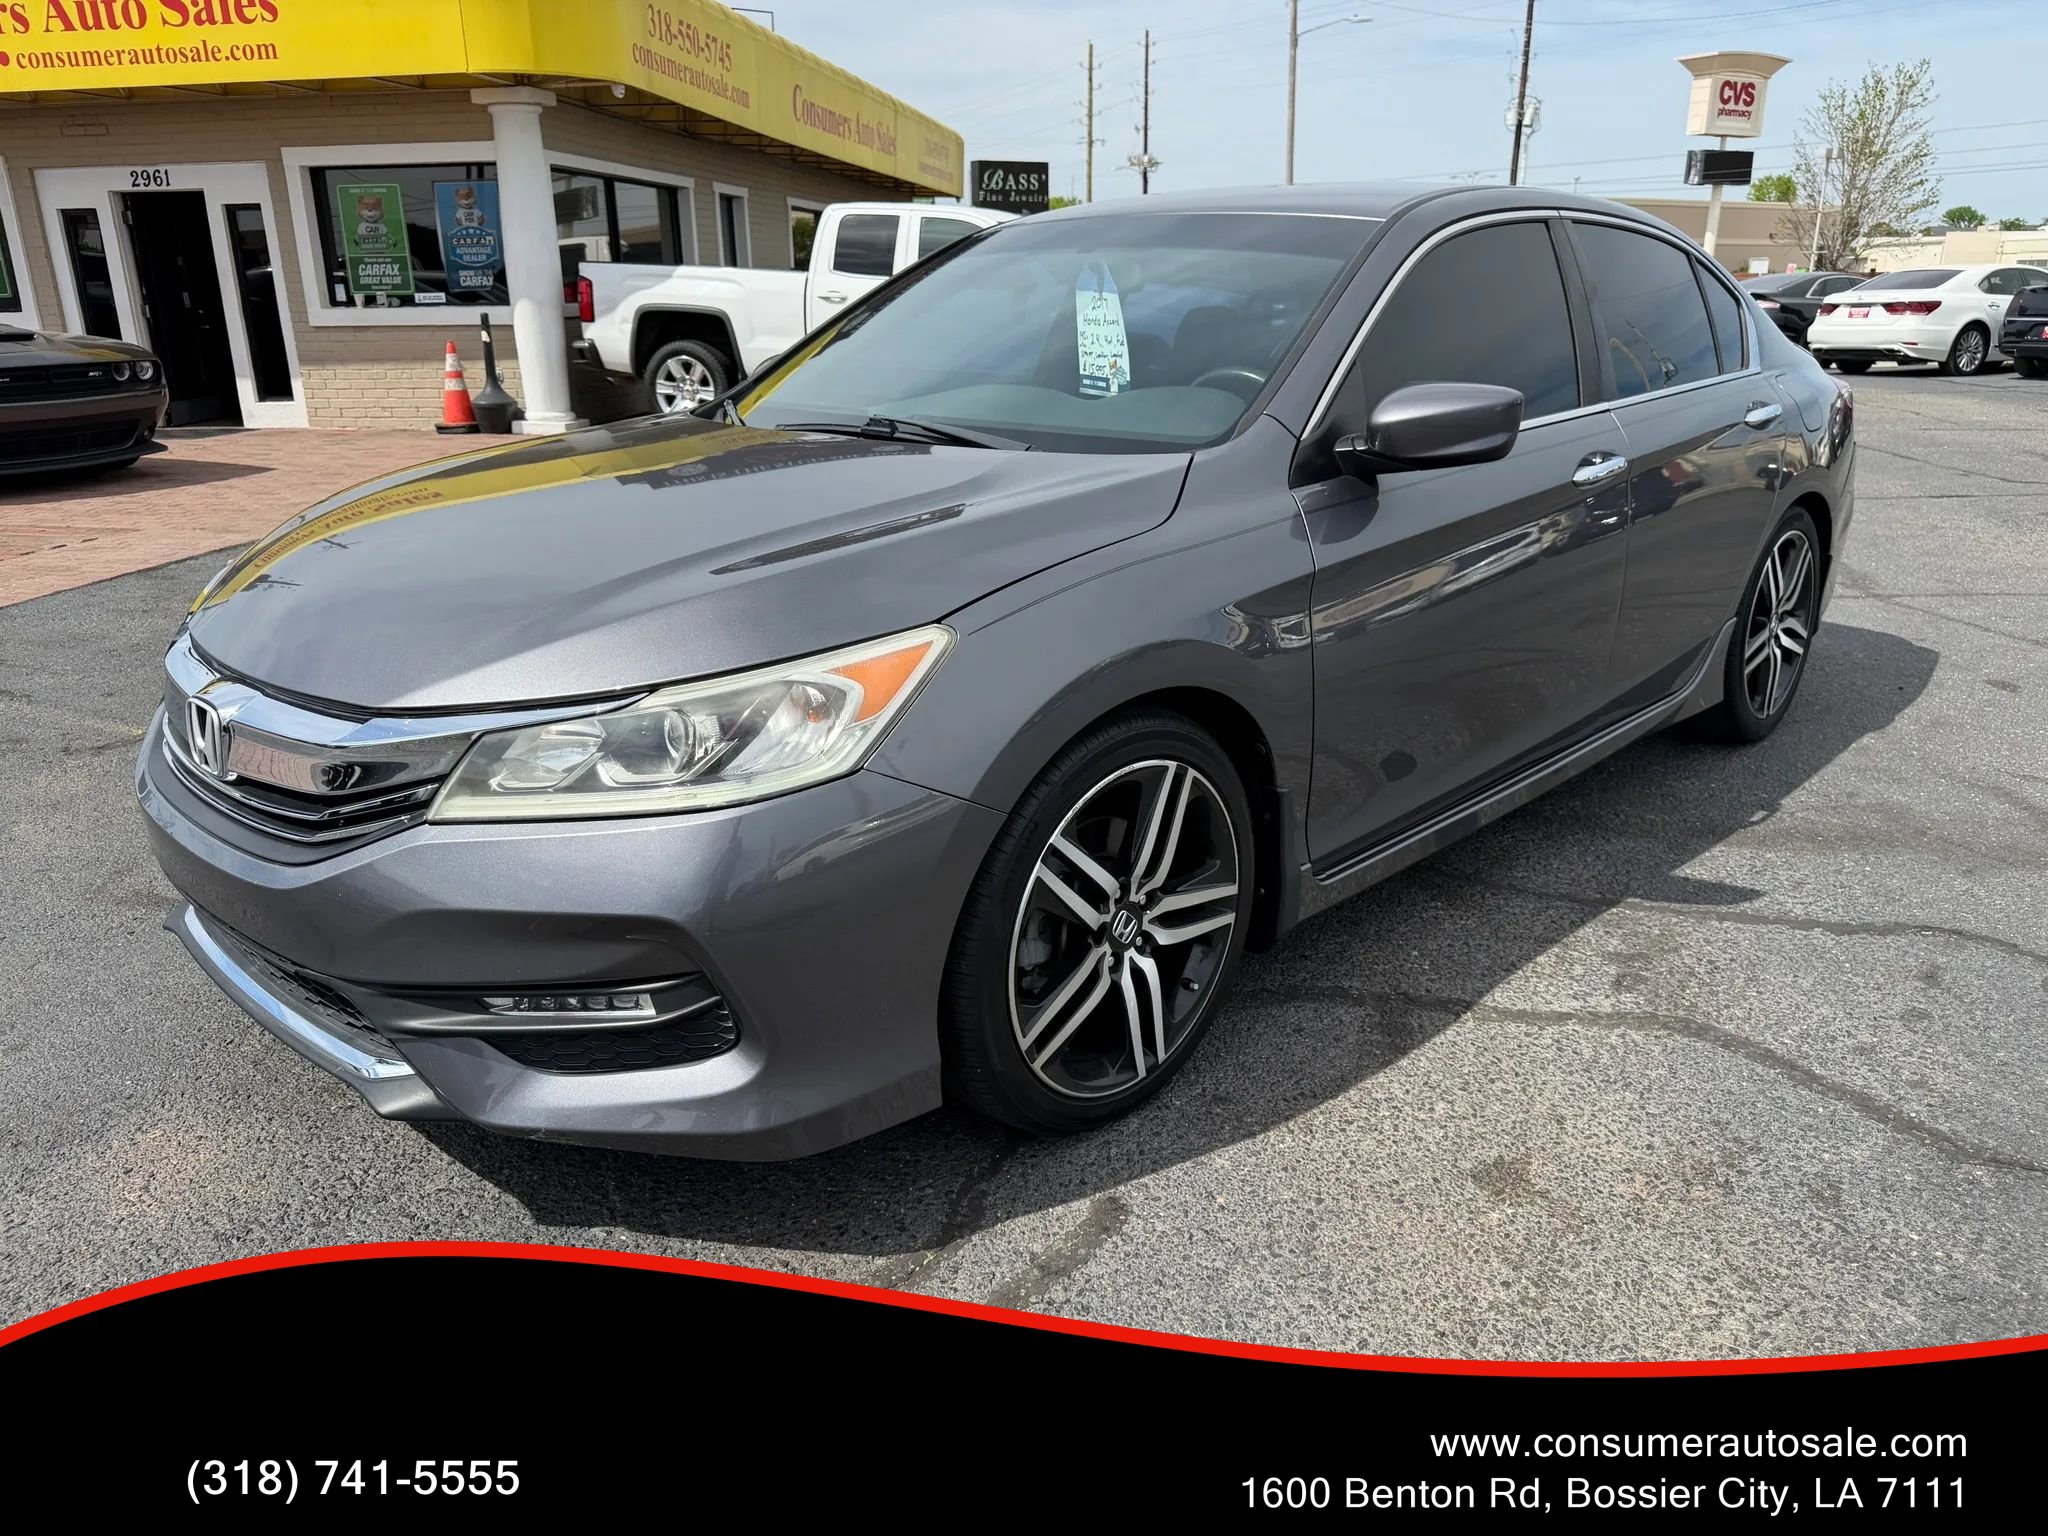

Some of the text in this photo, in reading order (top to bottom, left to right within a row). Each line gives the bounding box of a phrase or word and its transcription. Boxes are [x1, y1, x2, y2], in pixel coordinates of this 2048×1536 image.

[43, 0, 148, 33] Auto
[158, 0, 279, 28] Sales
[648, 3, 732, 72] 318-550-5745
[16, 40, 279, 69] consumerautosale.com
[632, 43, 750, 109] consumerautosale.com
[1719, 80, 1756, 107] CVS
[793, 84, 852, 142] Consumers
[1717, 107, 1752, 120] pharmacy
[130, 168, 171, 188] 2961
[365, 225, 380, 233] CAR
[358, 263, 400, 276] CARFAX
[460, 276, 494, 287] CARFAX
